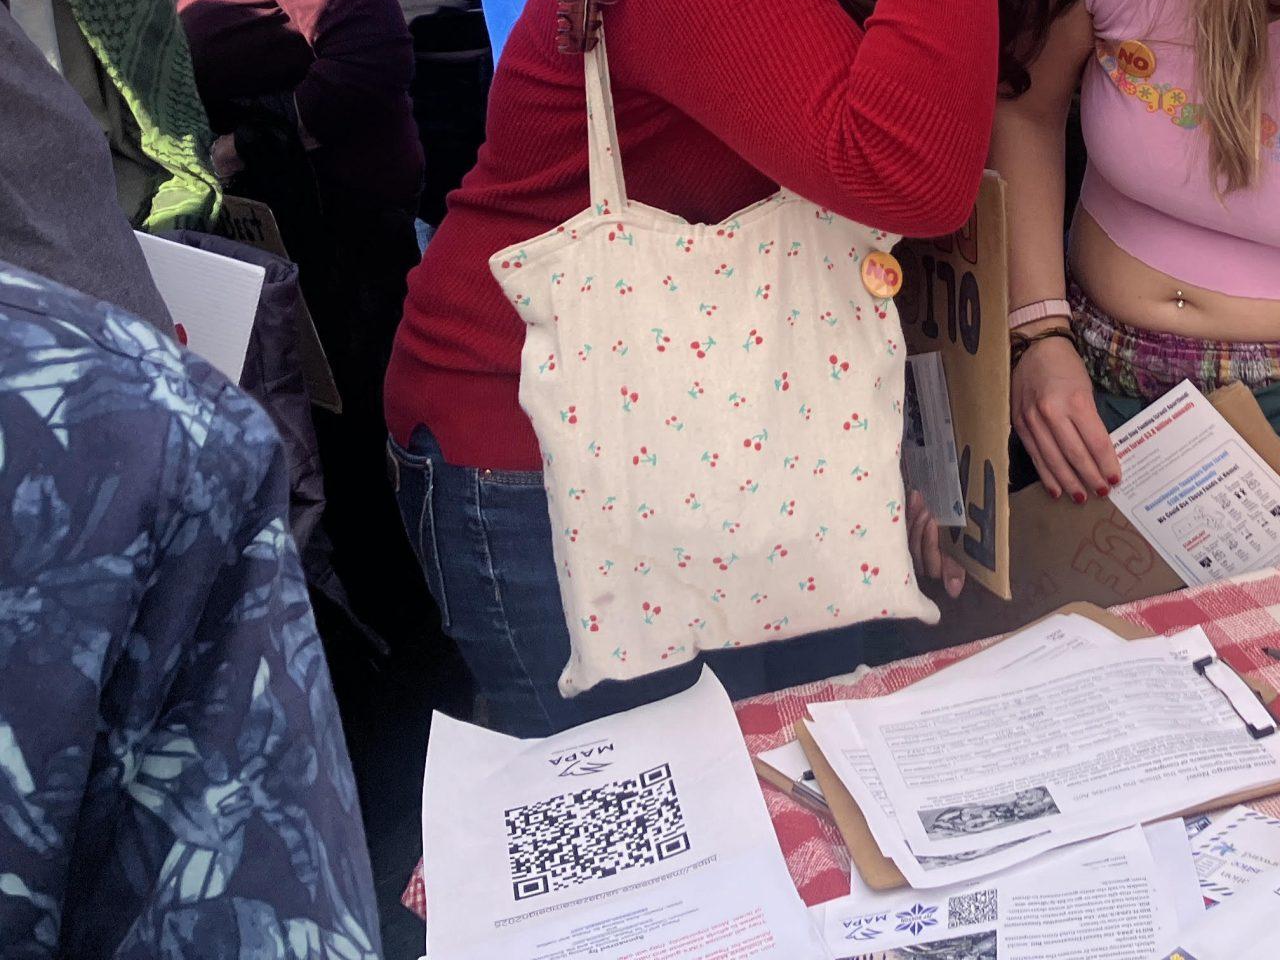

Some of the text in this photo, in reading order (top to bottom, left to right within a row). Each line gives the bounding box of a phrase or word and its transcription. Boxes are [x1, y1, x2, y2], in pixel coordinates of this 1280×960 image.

[1118, 50, 1150, 73] NO
[866, 259, 899, 287] NO
[547, 742, 615, 768] MAPA
[842, 912, 887, 929] MAPA
